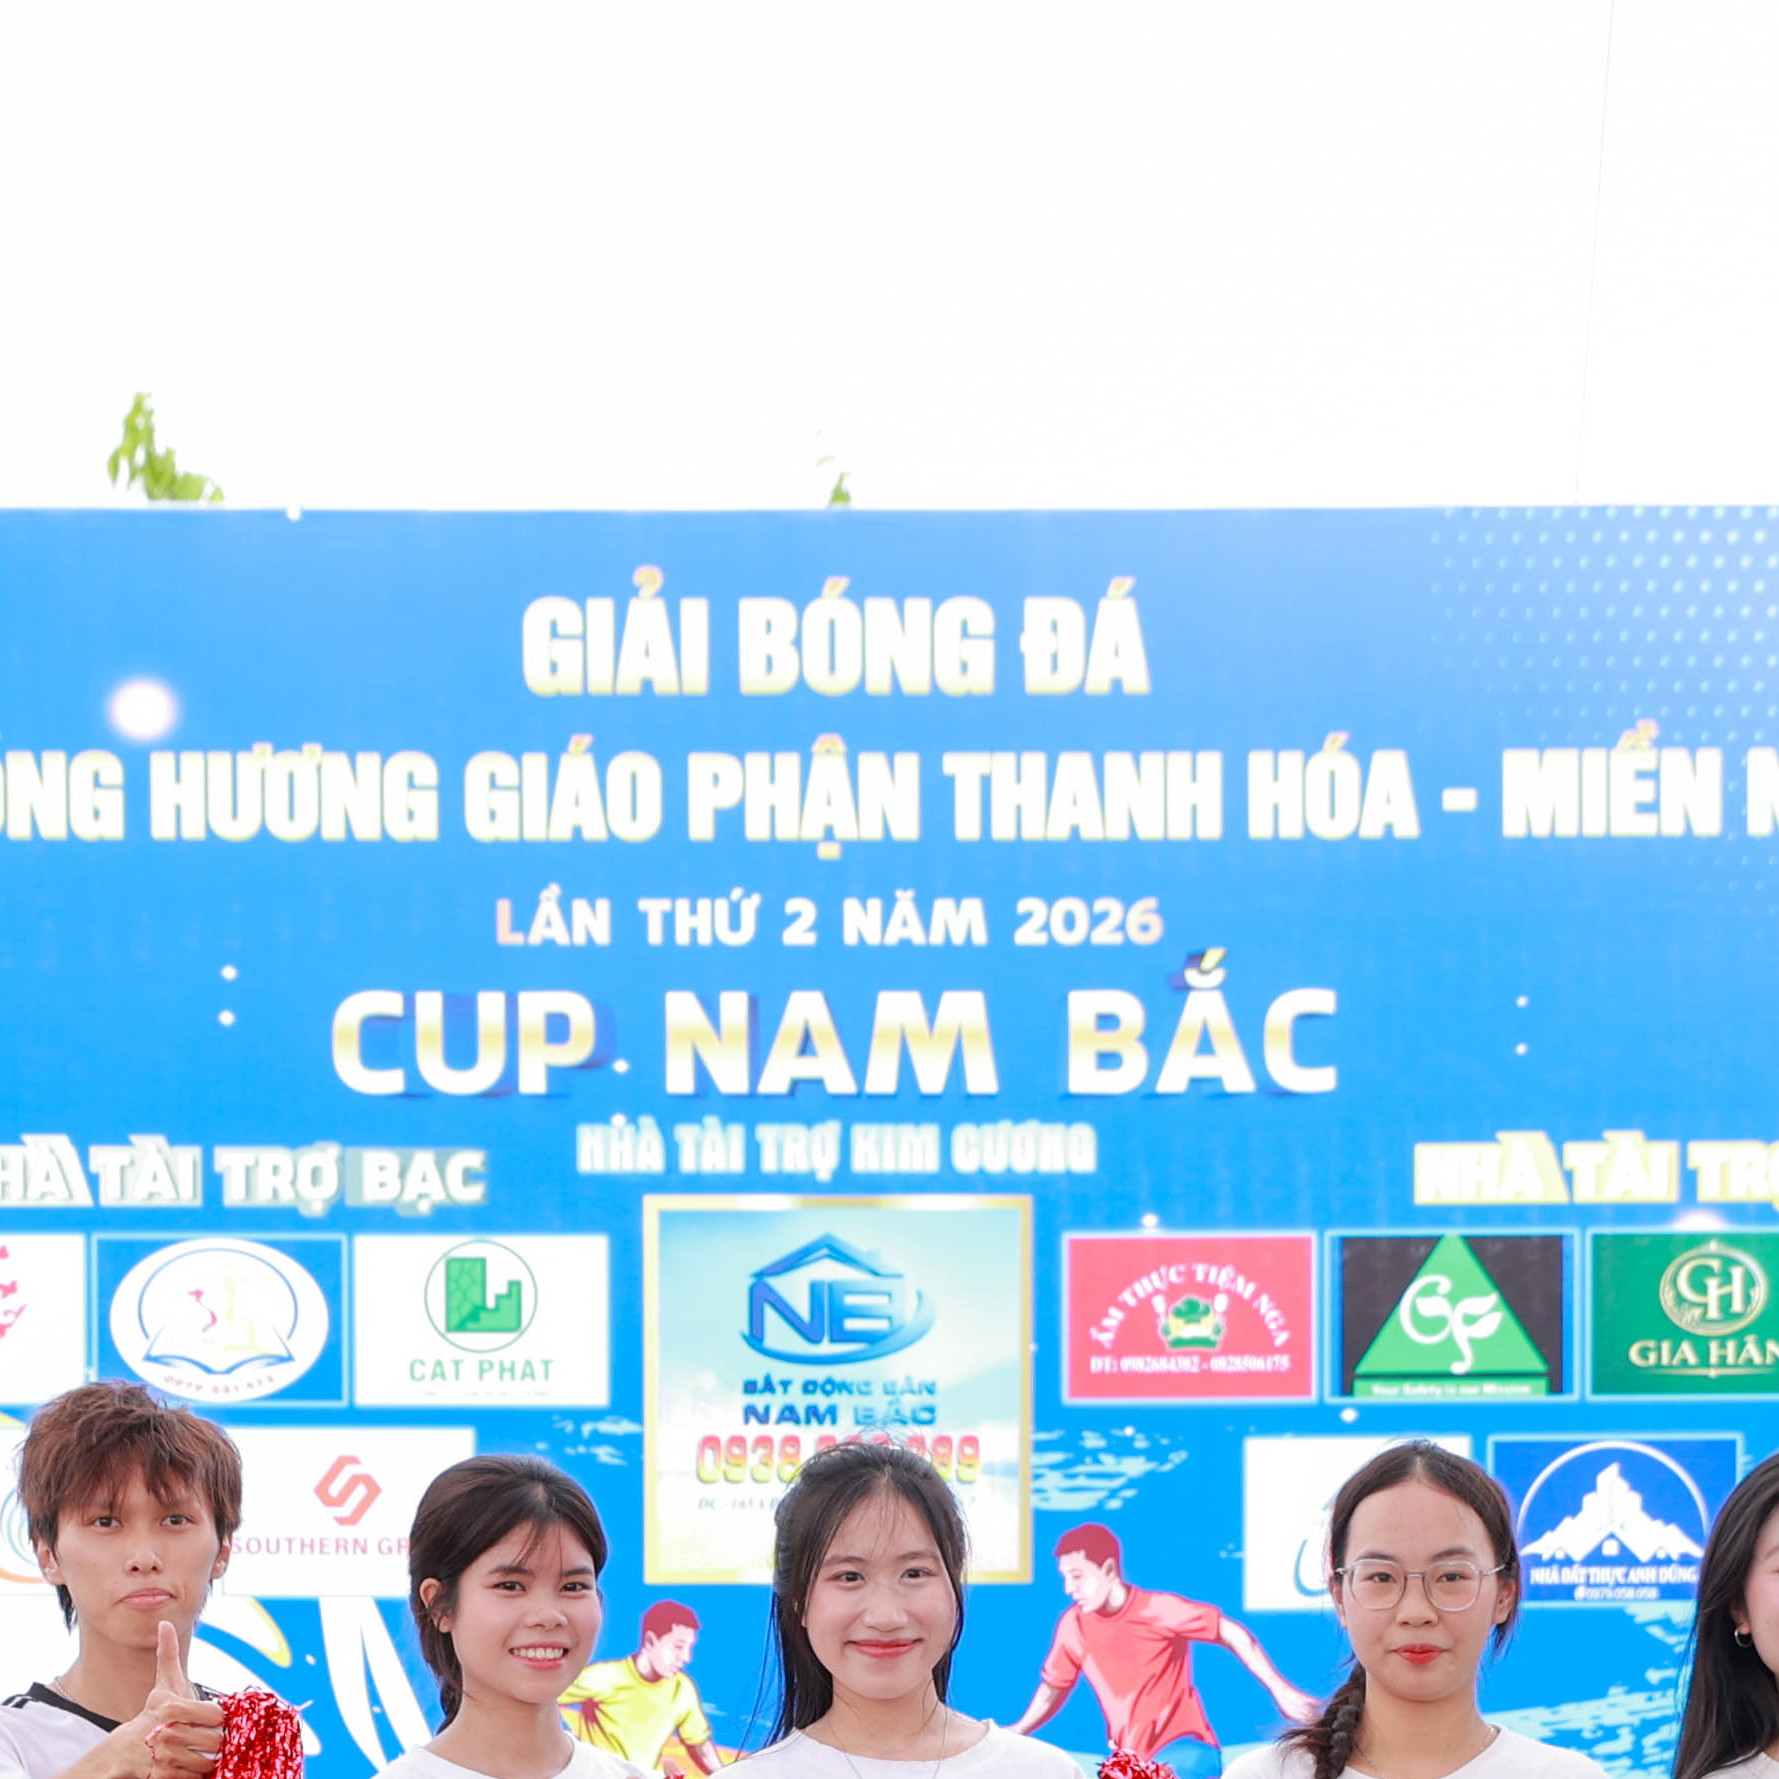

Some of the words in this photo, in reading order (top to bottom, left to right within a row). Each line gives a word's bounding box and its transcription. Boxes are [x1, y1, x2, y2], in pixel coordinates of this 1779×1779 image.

[522, 567, 709, 696] GIẢI
[738, 577, 994, 696] BÓNG
[1020, 577, 1151, 695] ĐÁ
[151, 740, 438, 843] HƯƠNG
[463, 734, 663, 843] GIÁO
[687, 734, 919, 858] PHẬN
[942, 750, 1222, 842] THANH
[1247, 732, 1420, 840] HÓA
[1502, 719, 1723, 837] MIỀN
[496, 883, 611, 946] LẦN
[639, 891, 759, 946] THỨ
[782, 898, 817, 945] 2
[841, 889, 987, 946] NĂM
[1014, 898, 1163, 946] 2026
[331, 989, 598, 1096] CUP
[664, 989, 999, 1096] NAM
[1067, 947, 1338, 1096] BẮC
[93, 1134, 202, 1207] TÀI
[218, 1142, 341, 1217] TRỢ
[359, 1148, 487, 1217] BẠC
[576, 1117, 666, 1174] NHÀ
[675, 1115, 745, 1174] TÀI
[756, 1119, 841, 1180] TRỢ
[852, 1122, 940, 1174] KIM
[1416, 1132, 1564, 1206] NHÀ
[1566, 1131, 1678, 1205] TÀI
[1118, 1264, 1185, 1307] THỰC
[1192, 1263, 1256, 1300] TIỆM
[1253, 1293, 1291, 1347] NGA
[1629, 1340, 1702, 1367] GIA
[742, 1404, 838, 1427] NAM
[230, 1538, 368, 1556] SOUTHERN
